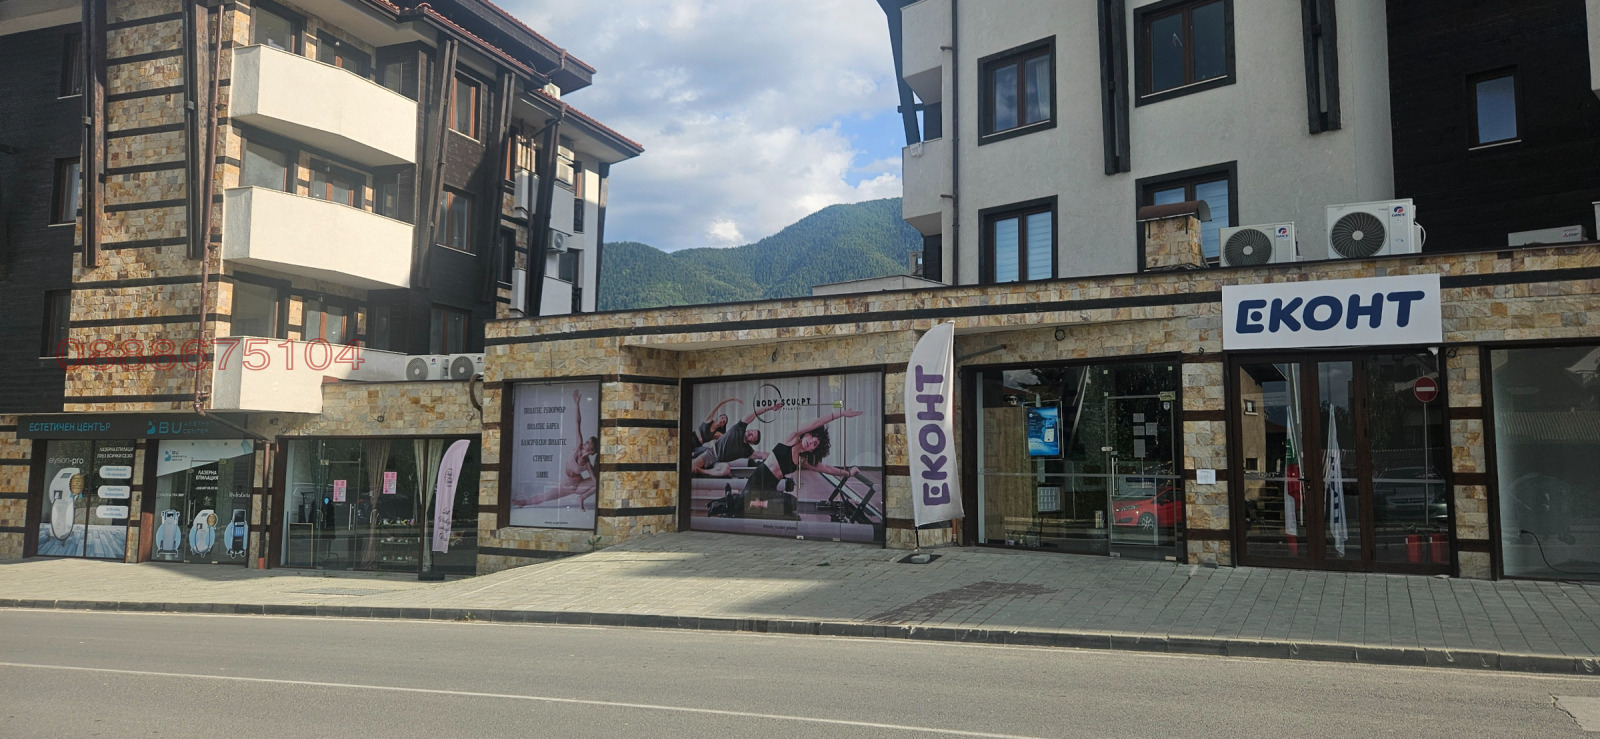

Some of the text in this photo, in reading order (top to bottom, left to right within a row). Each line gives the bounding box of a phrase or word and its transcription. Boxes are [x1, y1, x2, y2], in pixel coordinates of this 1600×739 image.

[1236, 291, 1425, 333] ЕКОНТ
[781, 398, 811, 406] SCULPT
[29, 422, 111, 432] ЕСТЕТИЧЕН ЦЕНТЪР
[158, 422, 182, 434] BU
[915, 365, 951, 506] ЕКОНТ
